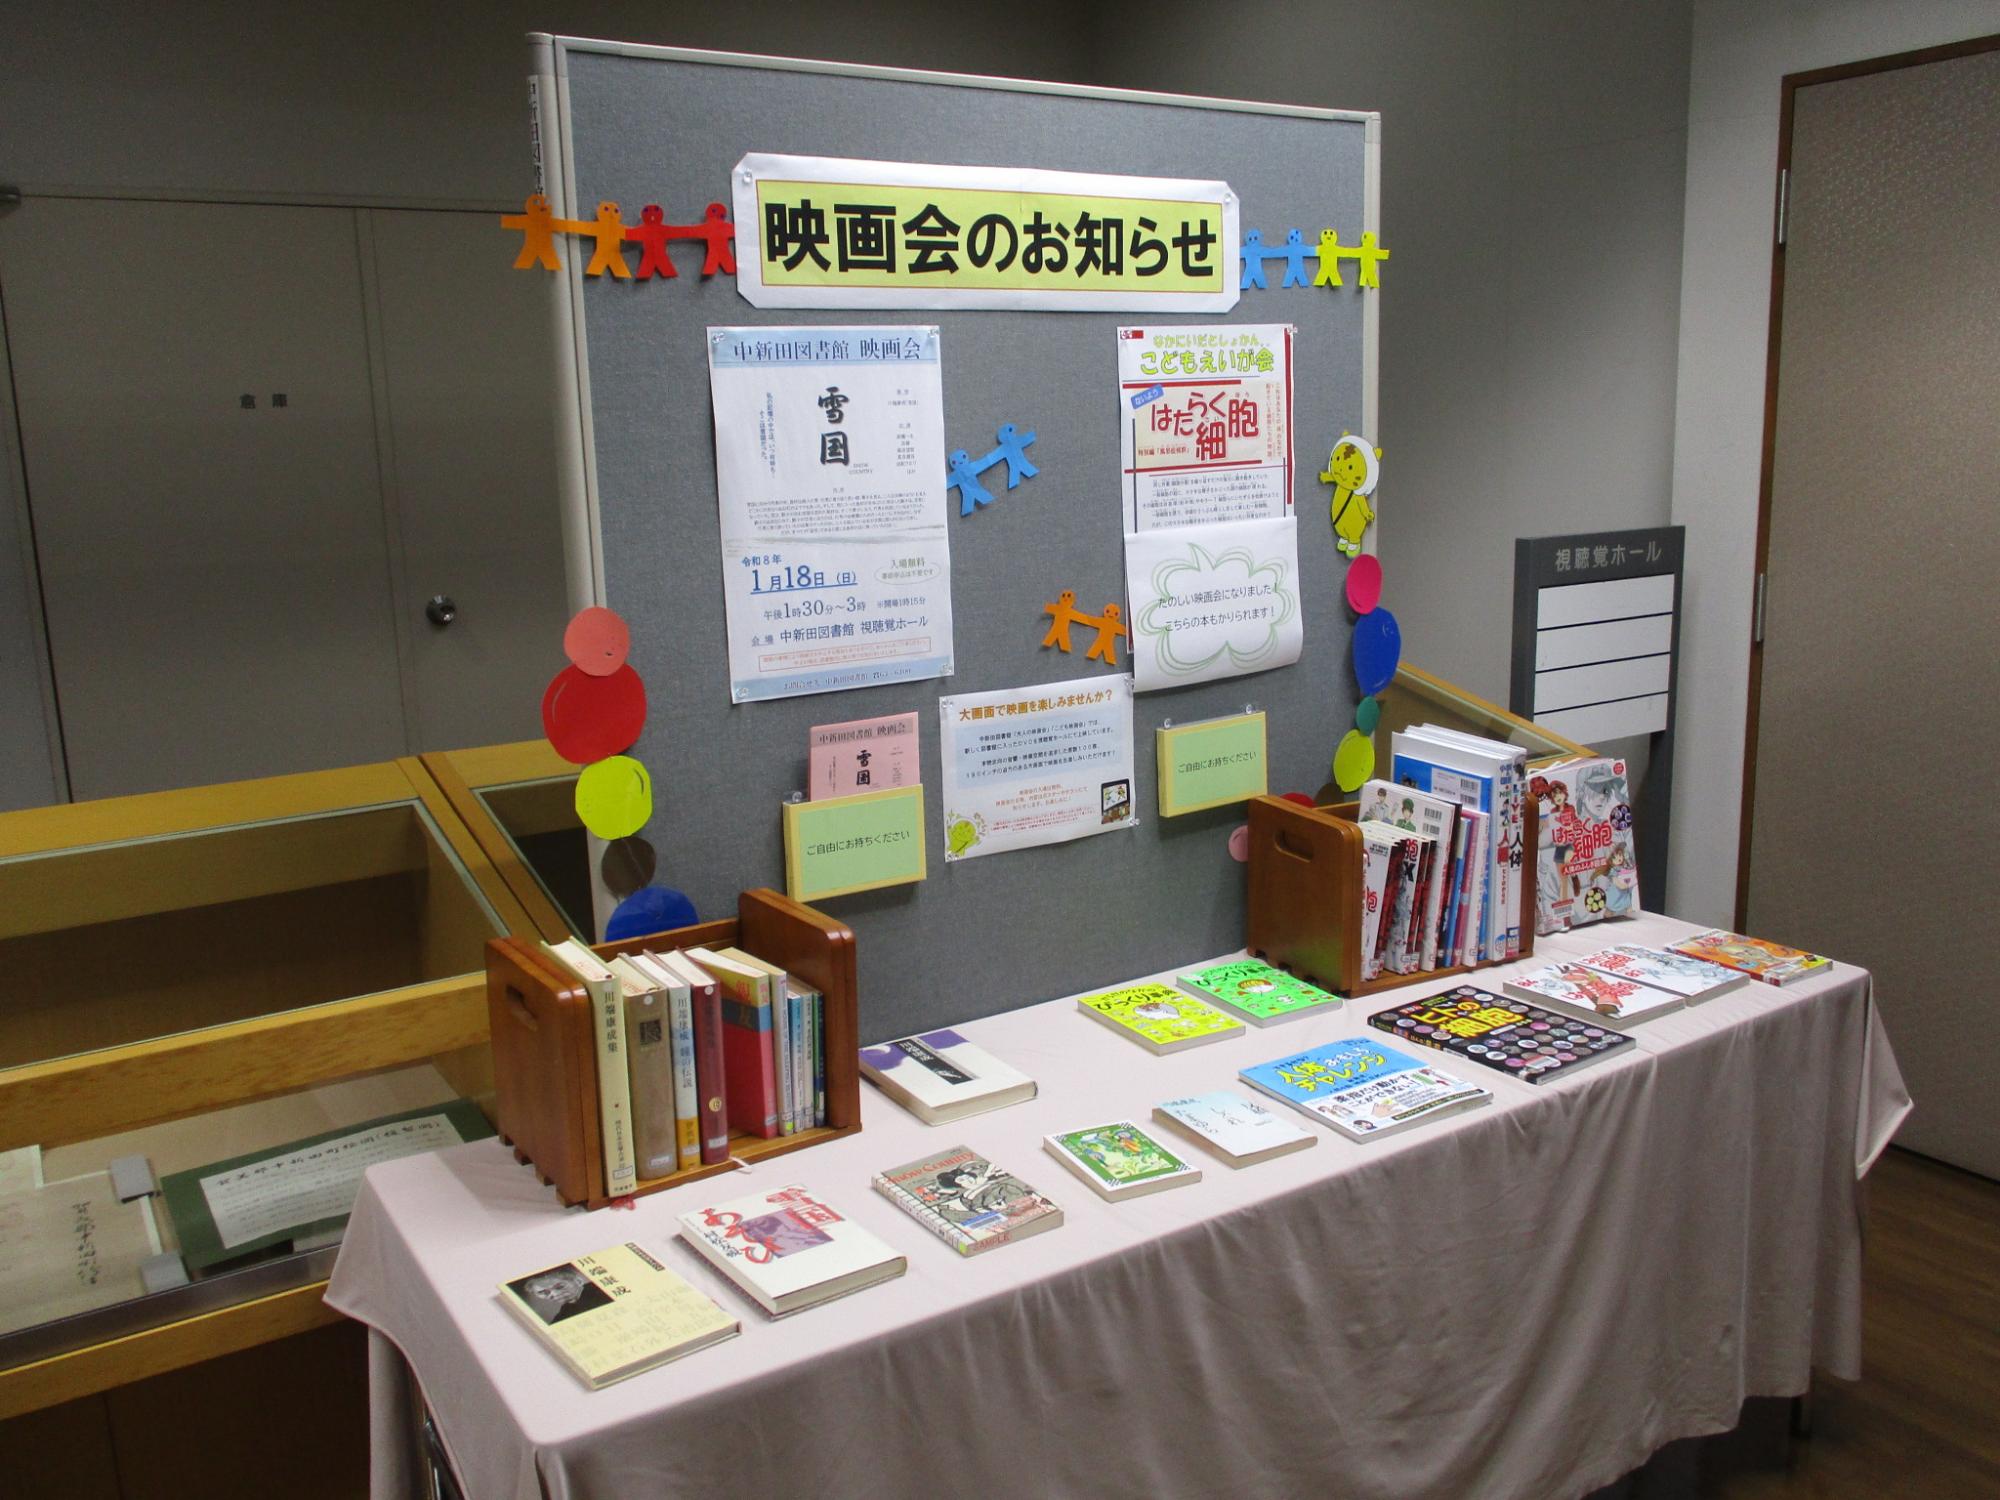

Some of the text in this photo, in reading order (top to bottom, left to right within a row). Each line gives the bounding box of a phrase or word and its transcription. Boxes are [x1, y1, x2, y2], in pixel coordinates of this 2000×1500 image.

[764, 199, 1217, 277] 映画会のお知らせ
[734, 337, 920, 361] 中新田図書館 映画会
[1140, 348, 1275, 375] こどもえいが会
[818, 386, 849, 466] 雪国
[1555, 541, 1662, 572] 視聴覚ホール
[780, 623, 855, 645] 中新田図書館
[861, 617, 929, 634] 視聴覚ホール
[1165, 606, 1275, 632] こちらの本もかりられます！
[959, 688, 1113, 722] 大画面で映画を楽しみませんか？
[1178, 751, 1257, 773] ご自由にお持ちください
[807, 829, 911, 857] ご自由にお持ちください
[1440, 1007, 1525, 1038] 細胞
[578, 1256, 632, 1297] 川端康成
